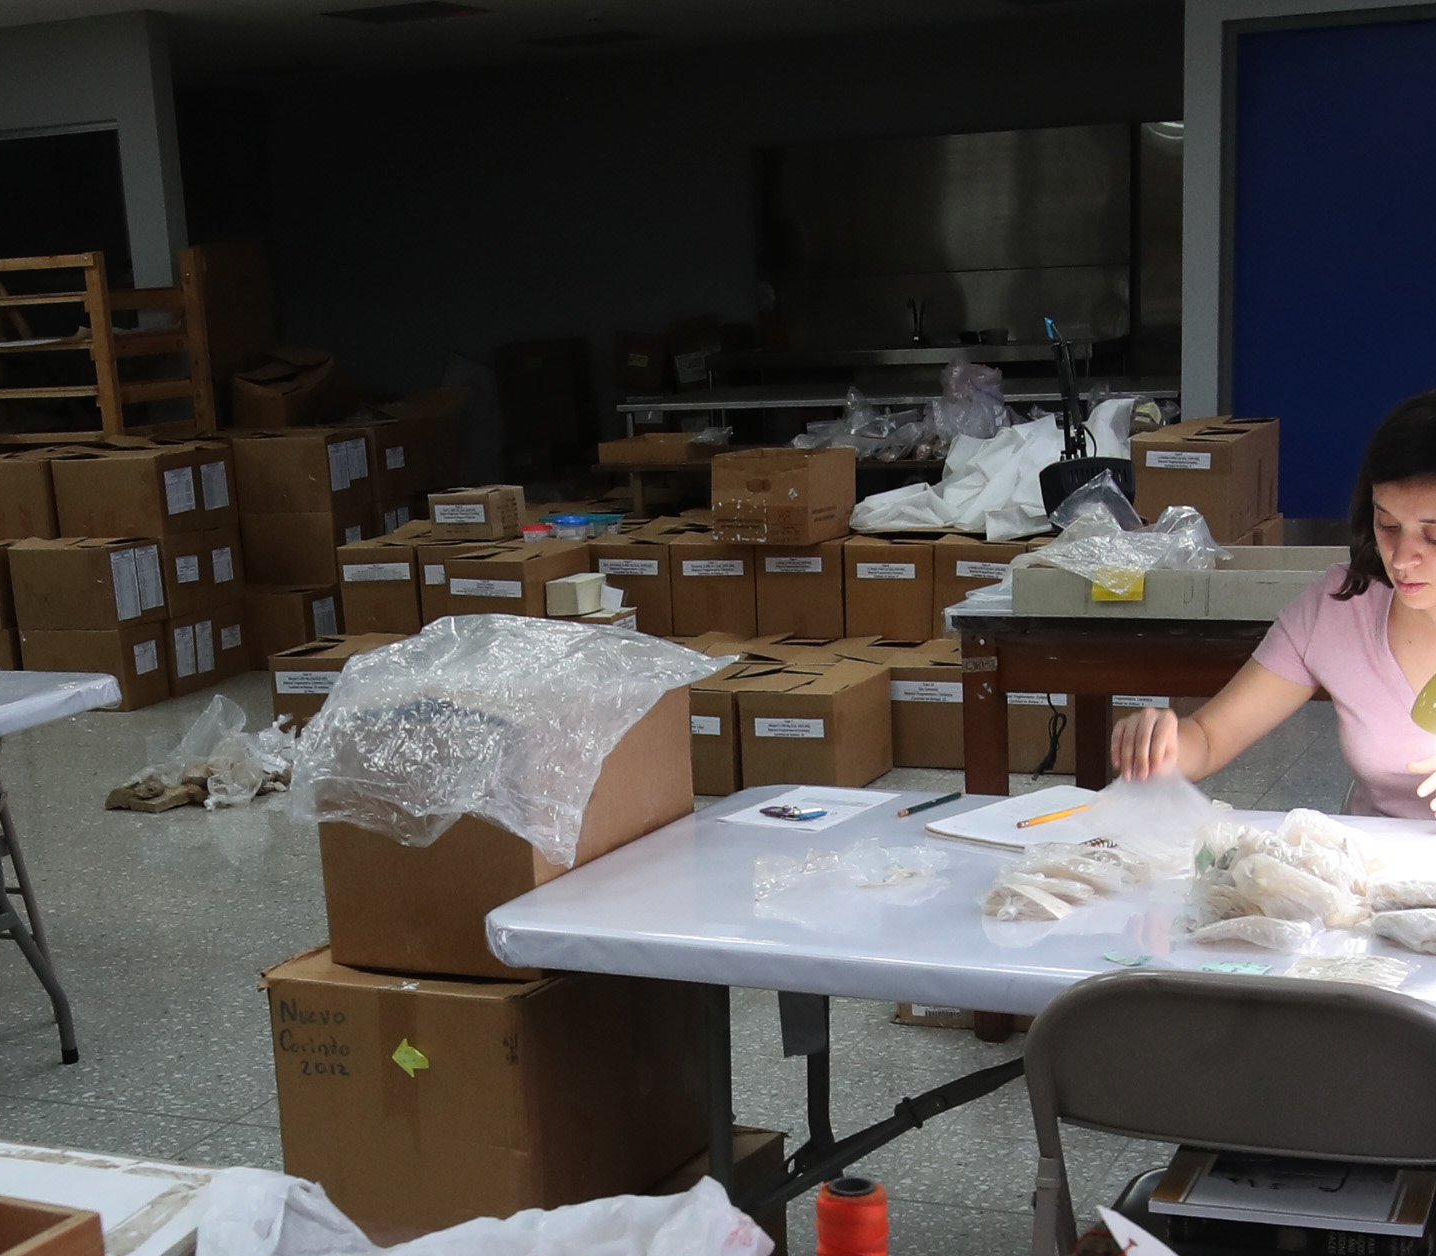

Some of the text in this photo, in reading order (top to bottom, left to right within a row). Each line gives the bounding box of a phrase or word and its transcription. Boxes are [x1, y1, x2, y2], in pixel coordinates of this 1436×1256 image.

[280, 998, 346, 1025] Nuevo
[280, 1028, 351, 1057] Corinto
[300, 1060, 351, 1077] 2012
